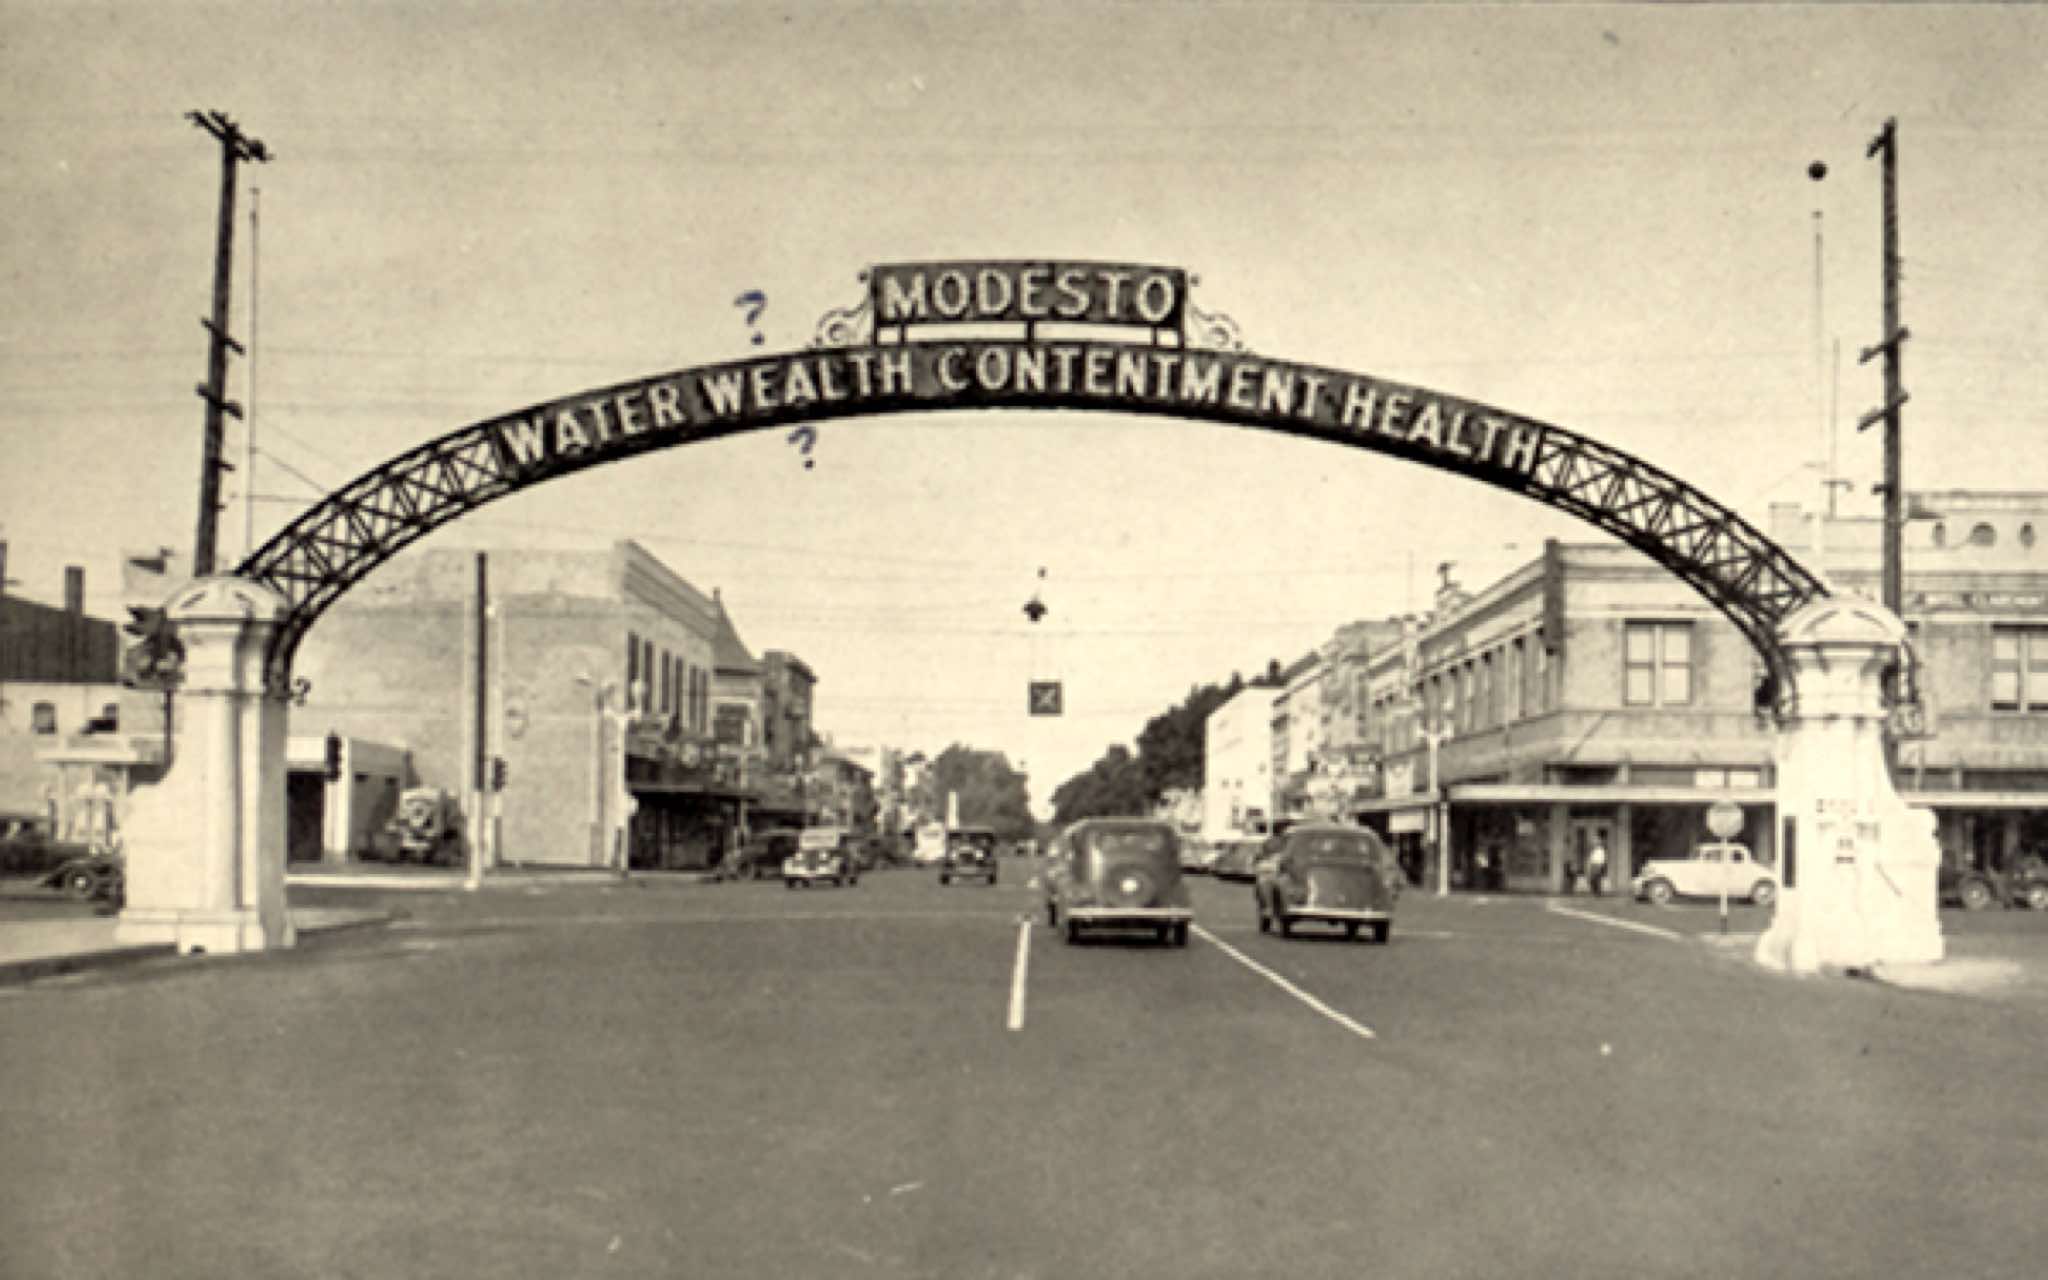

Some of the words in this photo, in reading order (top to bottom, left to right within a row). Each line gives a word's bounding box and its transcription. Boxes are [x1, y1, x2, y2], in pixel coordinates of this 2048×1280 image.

[883, 268, 1176, 322] MODESTO
[502, 384, 686, 466] WATER
[701, 350, 913, 416] WEALTH
[936, 347, 1327, 418] CONTENTMENT
[1341, 380, 1540, 474] HEALTH
